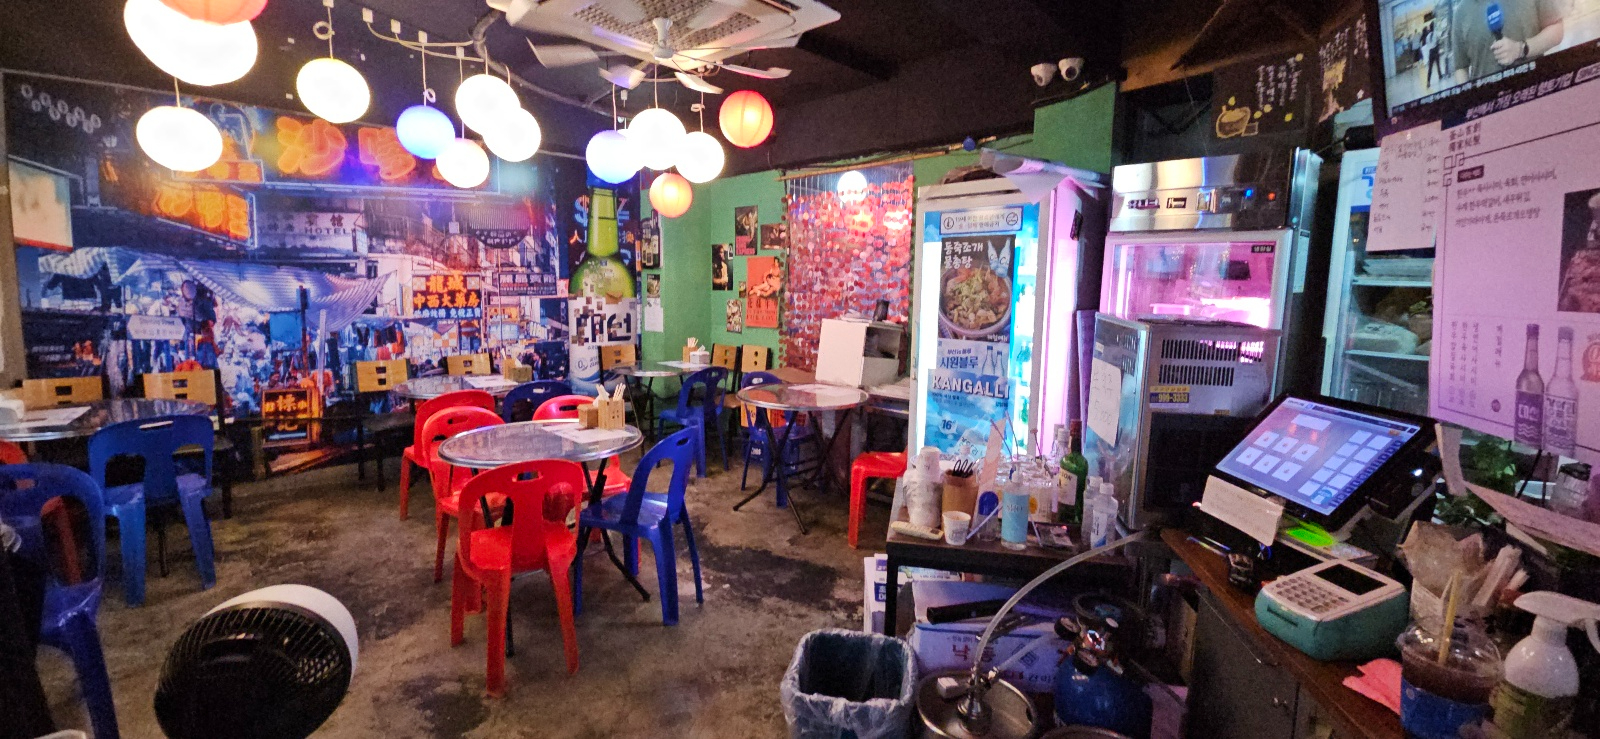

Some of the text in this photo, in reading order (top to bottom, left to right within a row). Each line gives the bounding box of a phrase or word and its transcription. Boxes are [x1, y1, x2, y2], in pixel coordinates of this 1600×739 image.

[304, 227, 347, 235] HOTEL
[944, 241, 984, 254] 동죽조개
[944, 256, 973, 269] 물총탕
[940, 356, 979, 369] 시원블루
[931, 375, 1010, 399] KANGALLI
